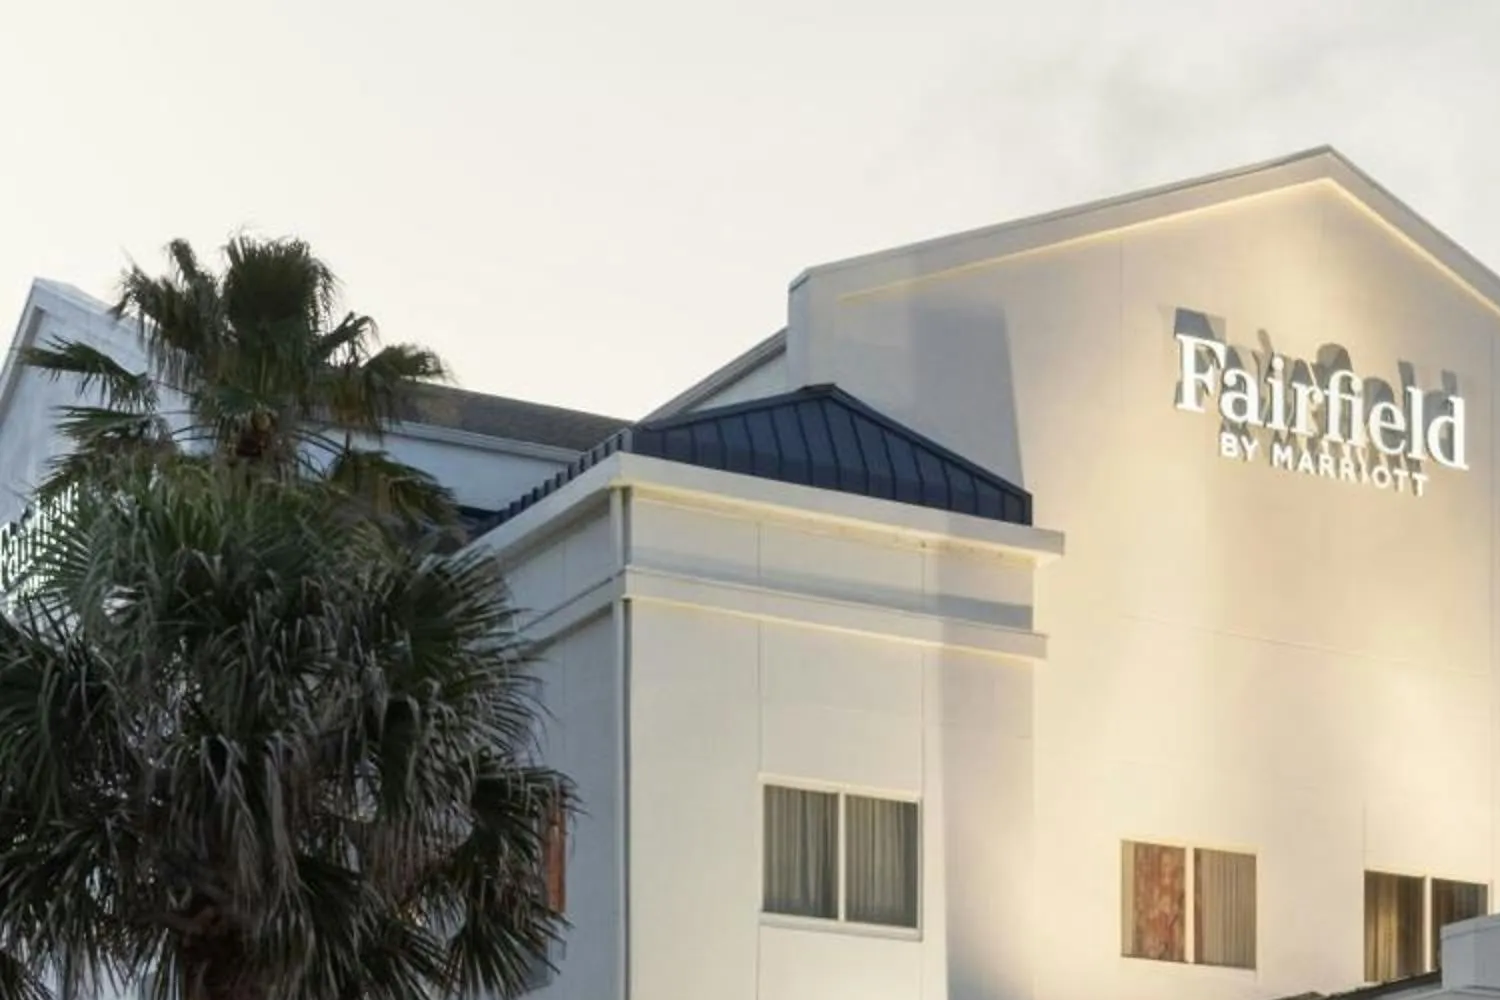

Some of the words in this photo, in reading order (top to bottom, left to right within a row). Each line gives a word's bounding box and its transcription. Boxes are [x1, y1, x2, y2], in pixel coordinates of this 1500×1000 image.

[1175, 333, 1469, 471] Fairfield
[1219, 431, 1258, 462] BY
[1272, 443, 1428, 497] MARRIOTT
